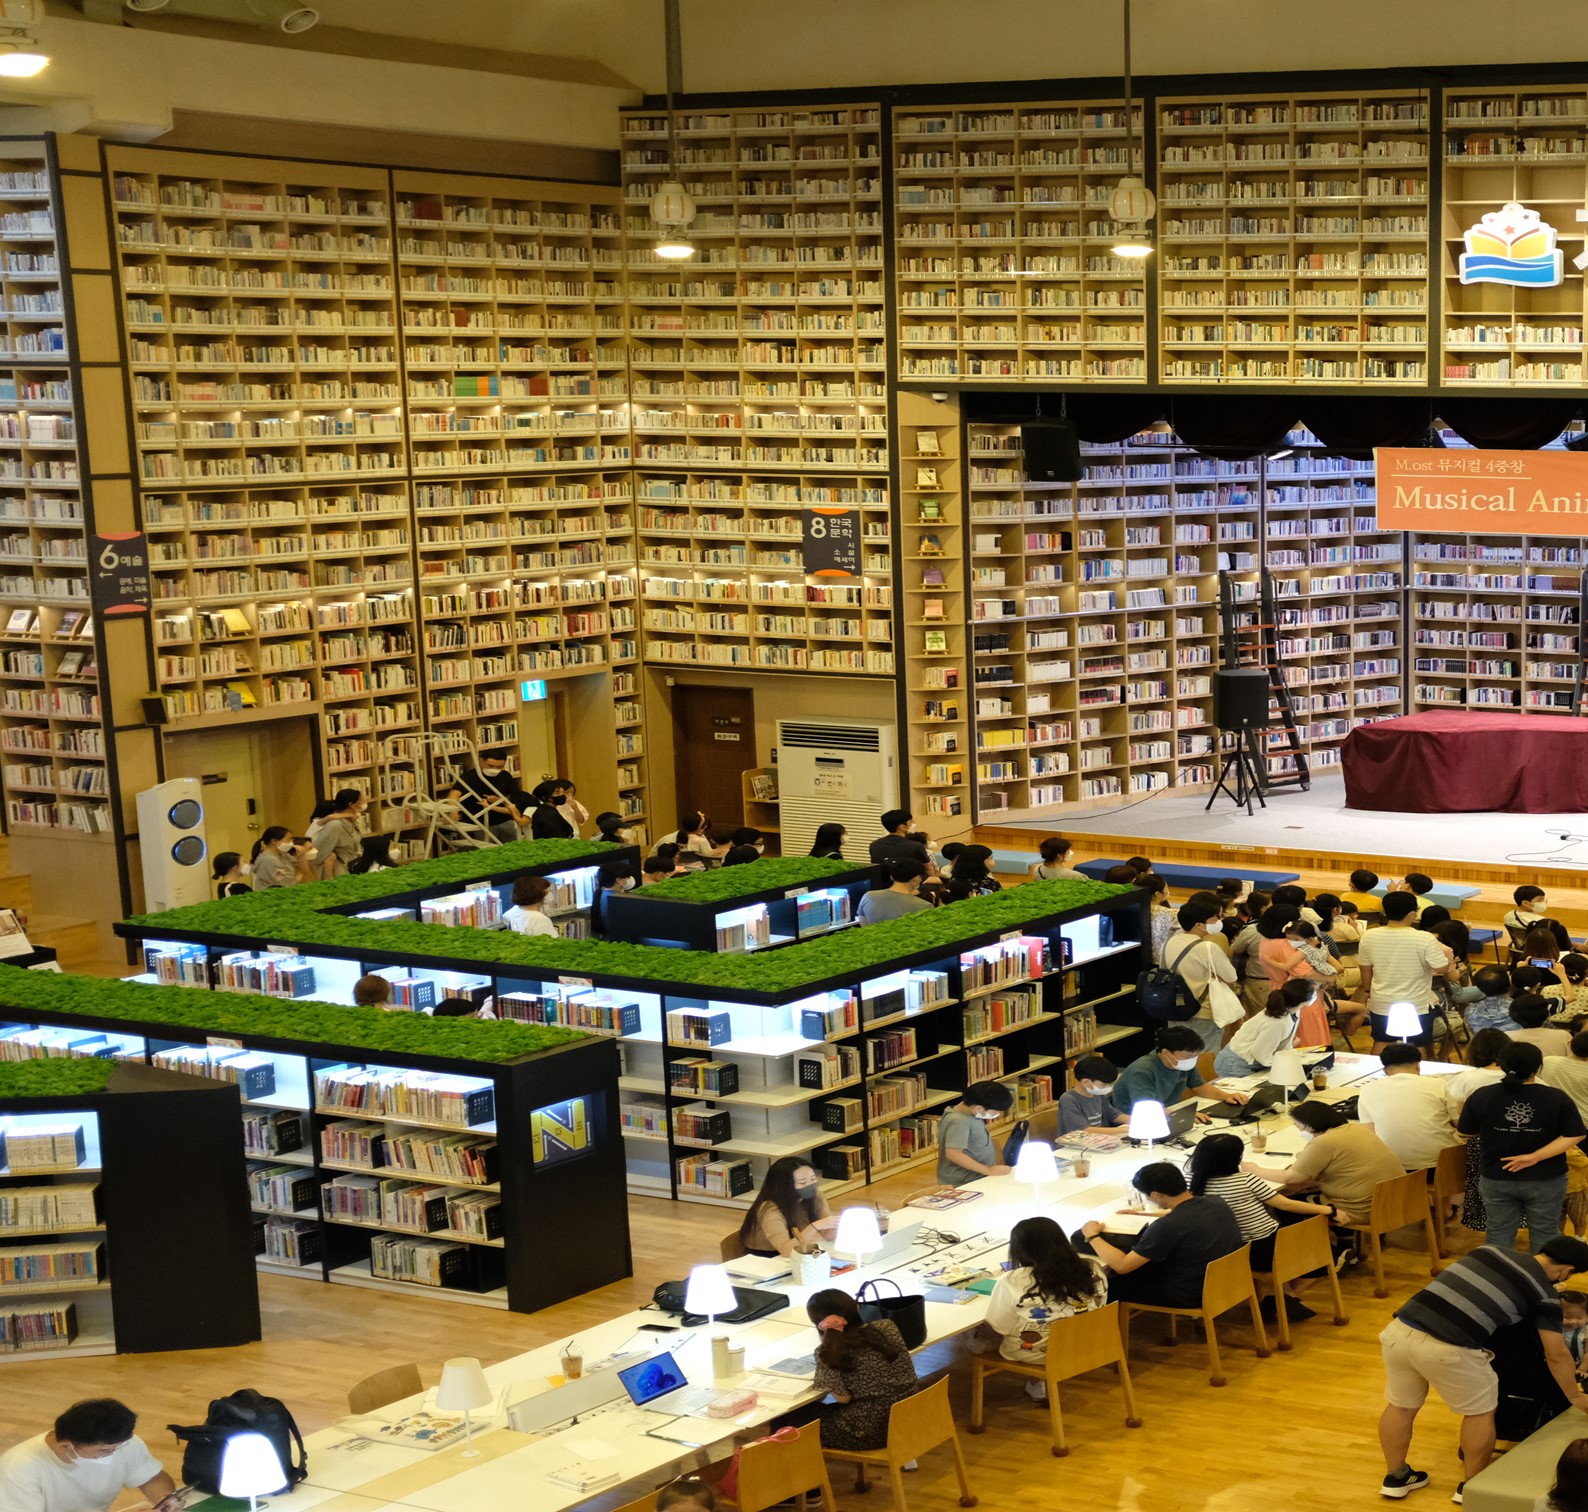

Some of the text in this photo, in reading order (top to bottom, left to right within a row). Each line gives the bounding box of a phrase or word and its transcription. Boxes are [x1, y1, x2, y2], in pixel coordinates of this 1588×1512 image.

[1395, 458, 1526, 475] M.ost 뮤지컬 4중창
[1392, 485, 1517, 512] Musical
[810, 516, 852, 539] 8 한국
[830, 528, 853, 539] 문학
[99, 543, 143, 570] 6 예술
